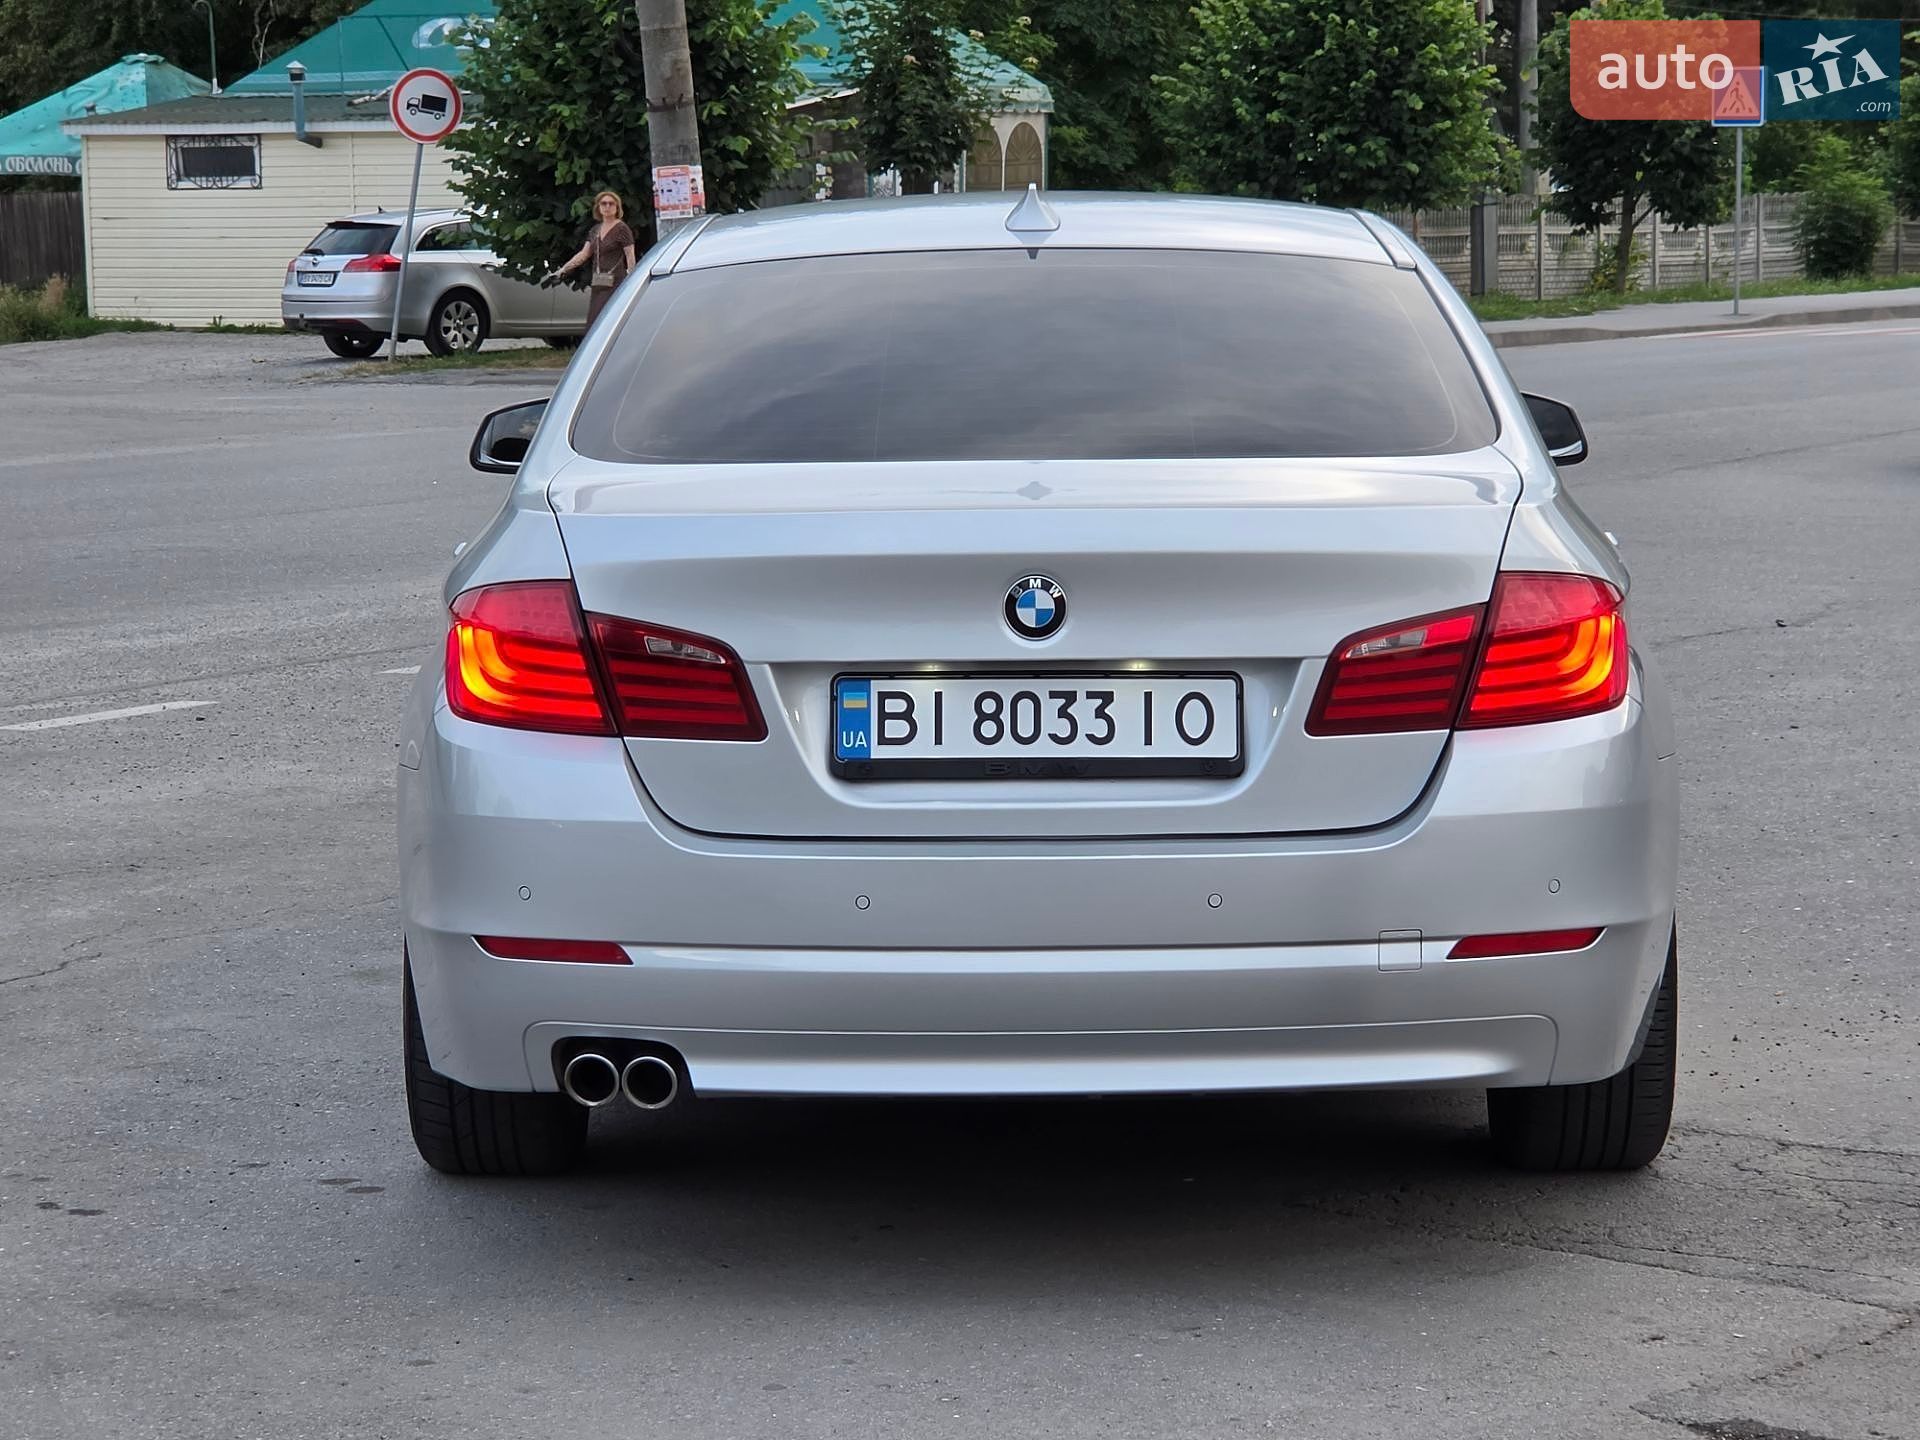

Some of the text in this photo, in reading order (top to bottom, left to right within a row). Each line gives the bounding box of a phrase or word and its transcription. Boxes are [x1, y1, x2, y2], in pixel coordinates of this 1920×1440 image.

[6, 156, 73, 173] ОБОЛОНЬ
[1010, 578, 1062, 599] BMW
[877, 691, 943, 746] BI
[972, 690, 1116, 746] 8033
[843, 731, 868, 748] UA
